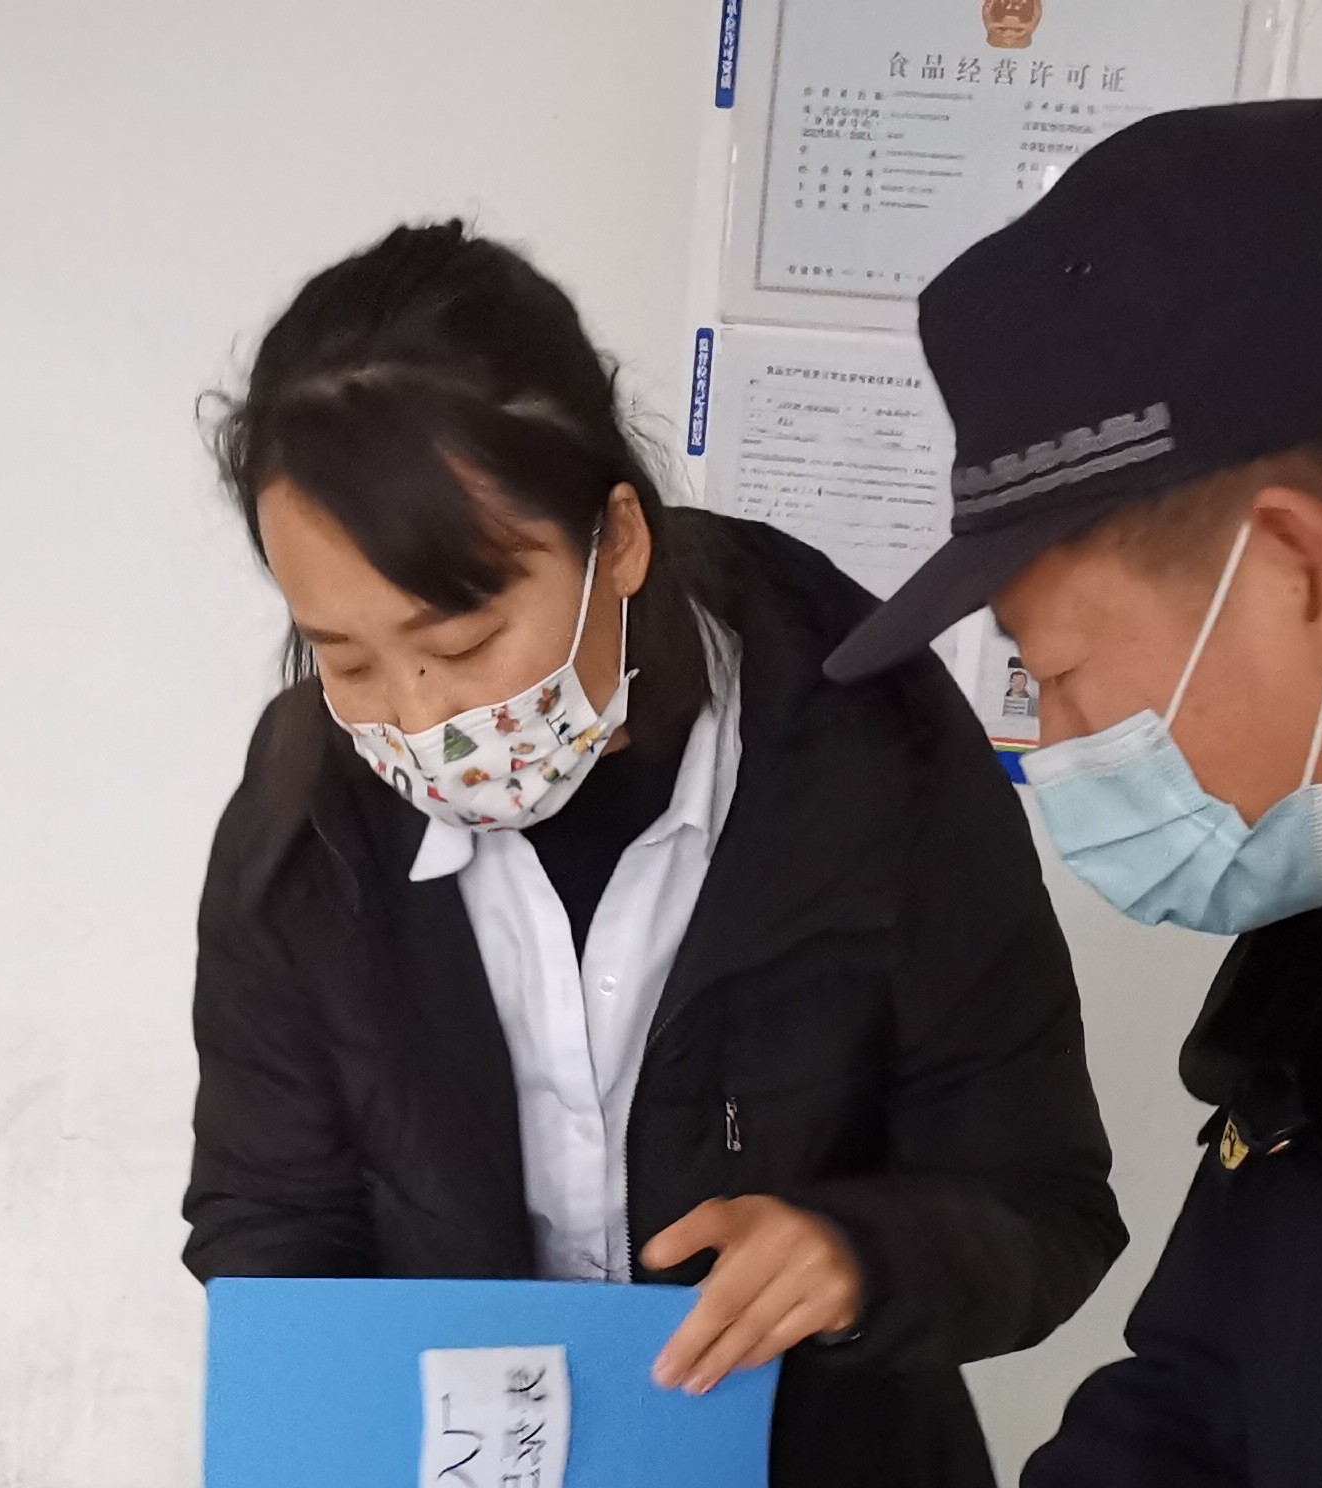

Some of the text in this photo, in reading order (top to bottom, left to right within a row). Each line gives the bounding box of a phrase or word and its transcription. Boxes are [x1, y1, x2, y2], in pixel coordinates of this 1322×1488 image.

[889, 51, 1126, 93] 食品经营许可证
